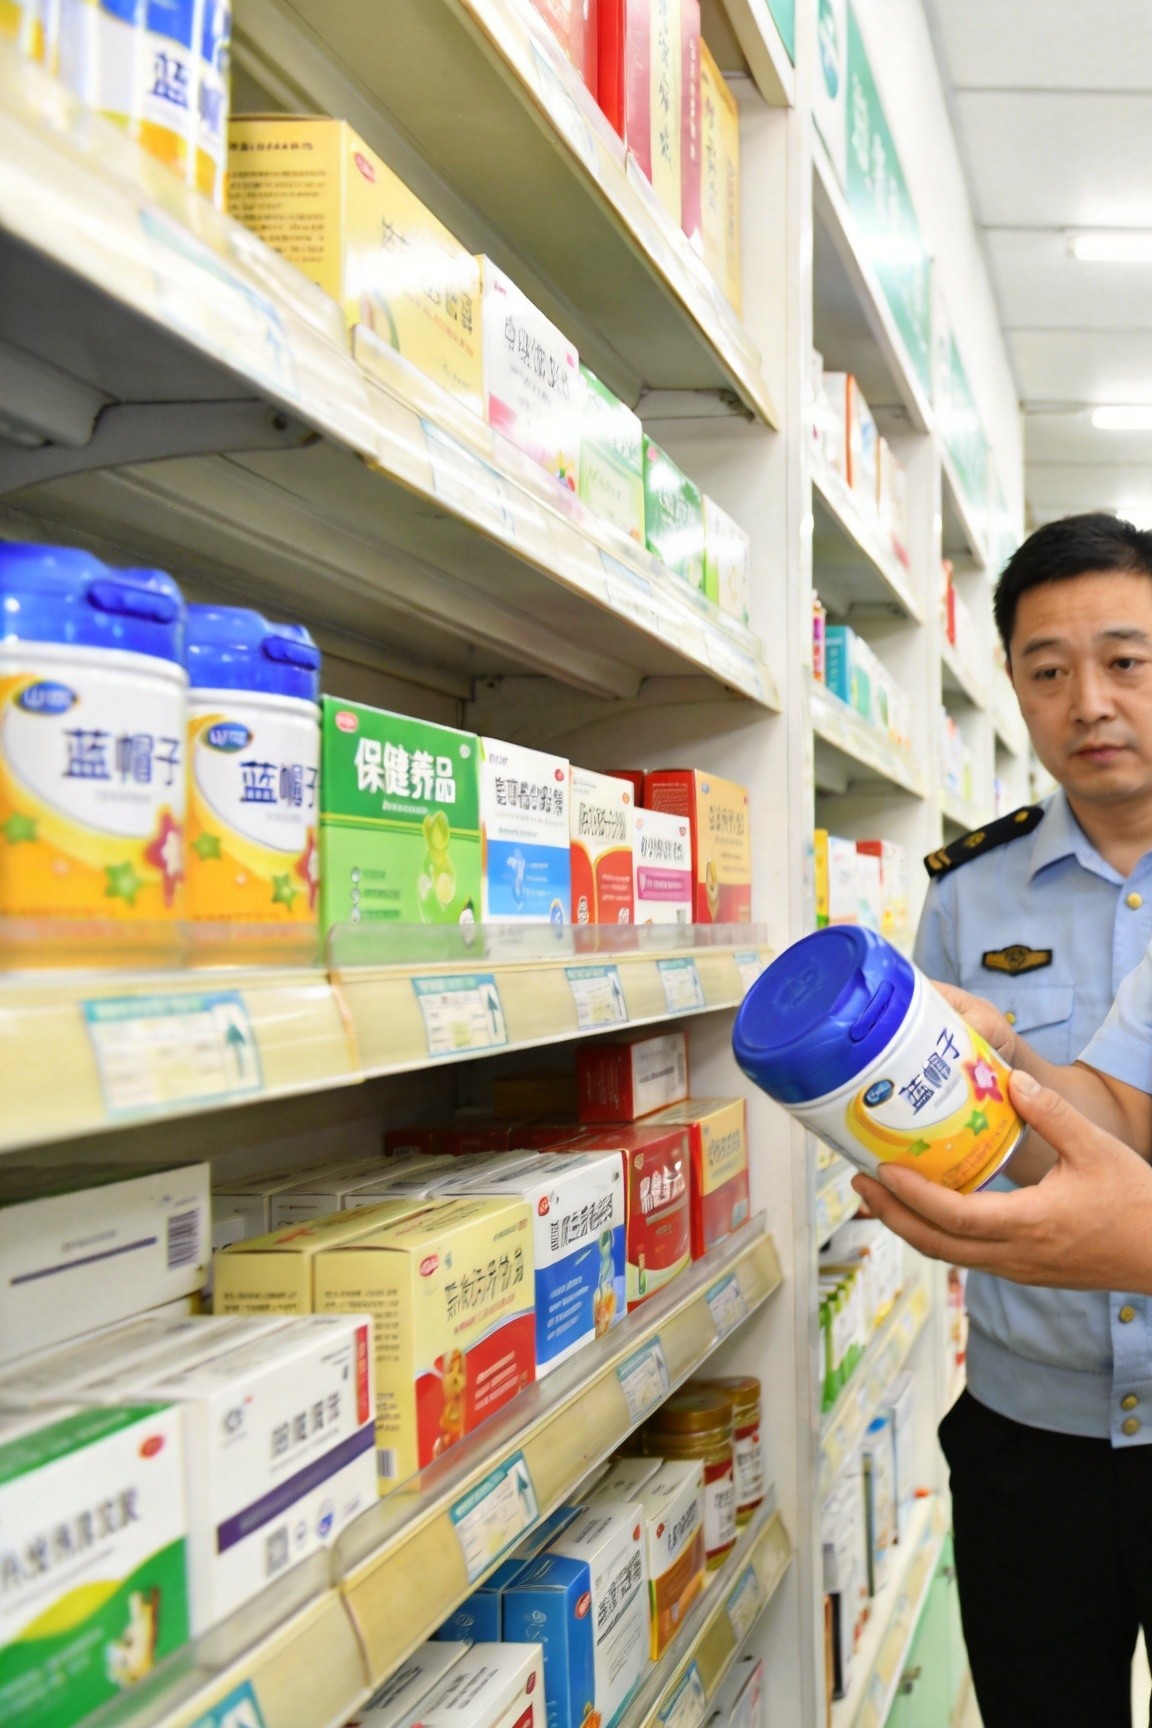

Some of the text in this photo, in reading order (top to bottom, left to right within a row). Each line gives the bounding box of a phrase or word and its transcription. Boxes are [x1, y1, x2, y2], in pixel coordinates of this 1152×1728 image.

[354, 737, 456, 804] 保健养品
[898, 1028, 960, 1115] 蓝帽子
